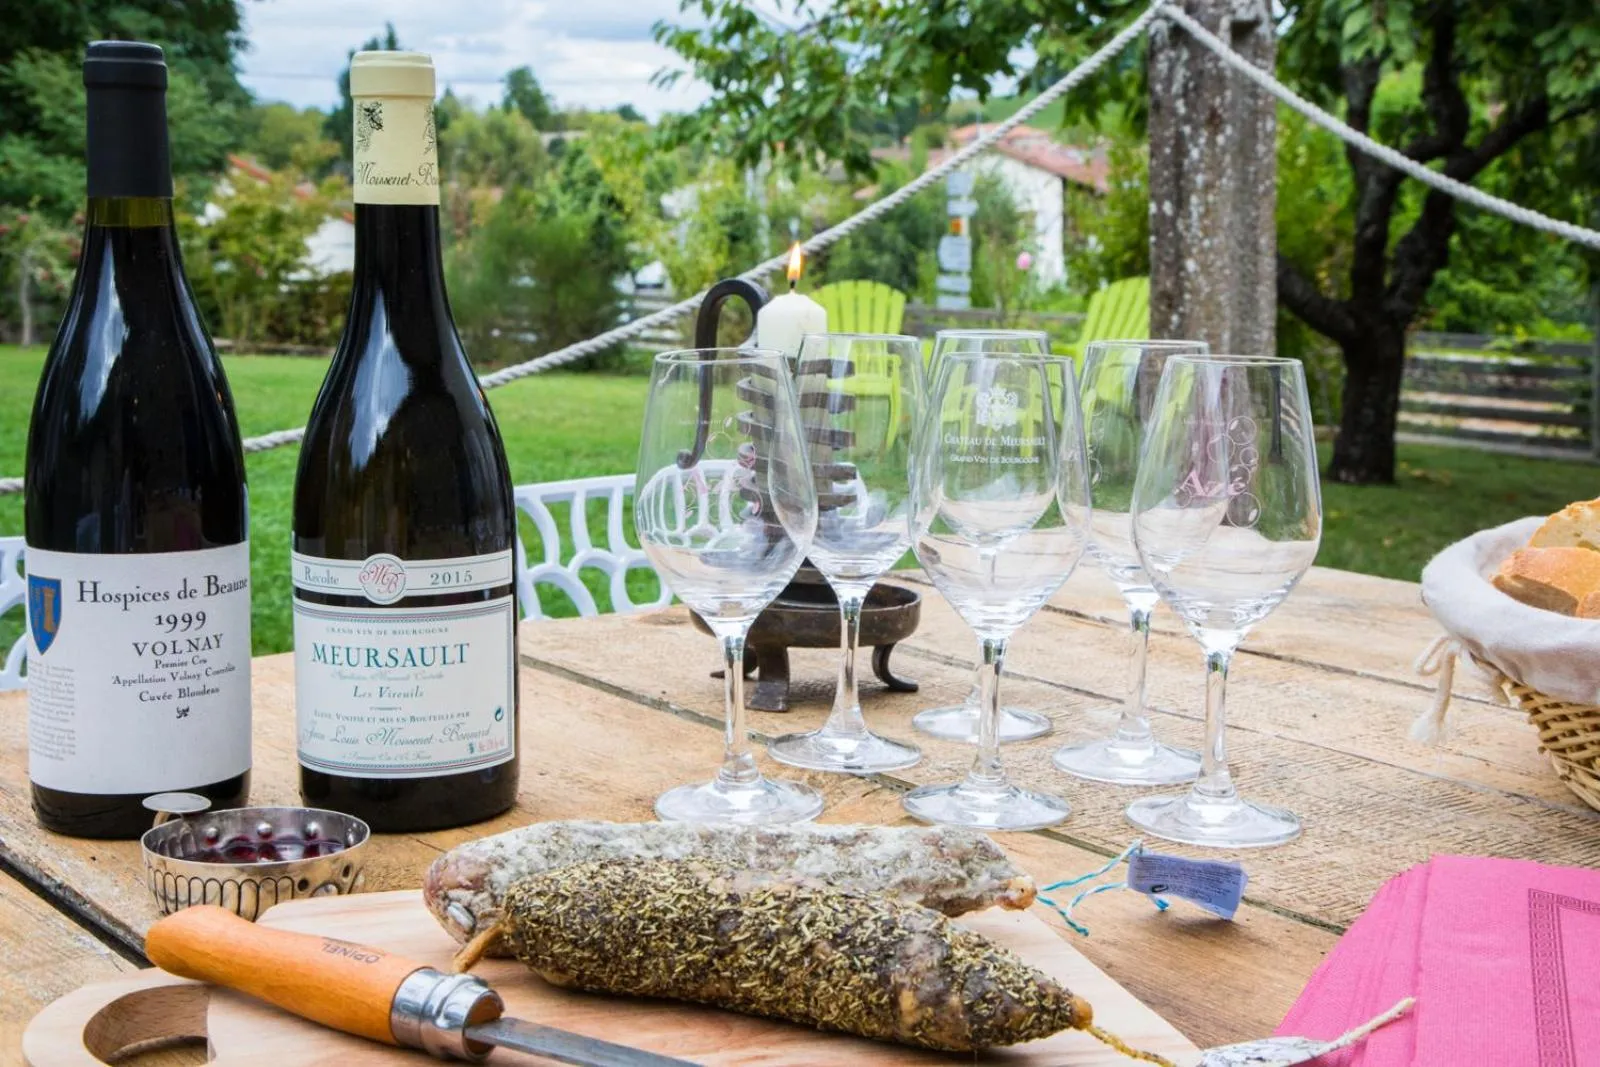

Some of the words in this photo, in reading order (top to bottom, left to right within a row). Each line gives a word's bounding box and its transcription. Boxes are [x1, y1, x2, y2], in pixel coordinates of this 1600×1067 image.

[430, 570, 473, 586] 2015
[77, 580, 170, 611] Hospices
[177, 578, 198, 600] de
[203, 574, 248, 597] Beaune
[154, 611, 207, 633] 1999
[132, 633, 224, 657] VOLNAY
[312, 642, 470, 668] MEURSAULT
[112, 674, 166, 687] Appellation
[170, 671, 202, 683] Volnay
[139, 690, 173, 702] Cuvée
[322, 943, 380, 963] OPINEL
